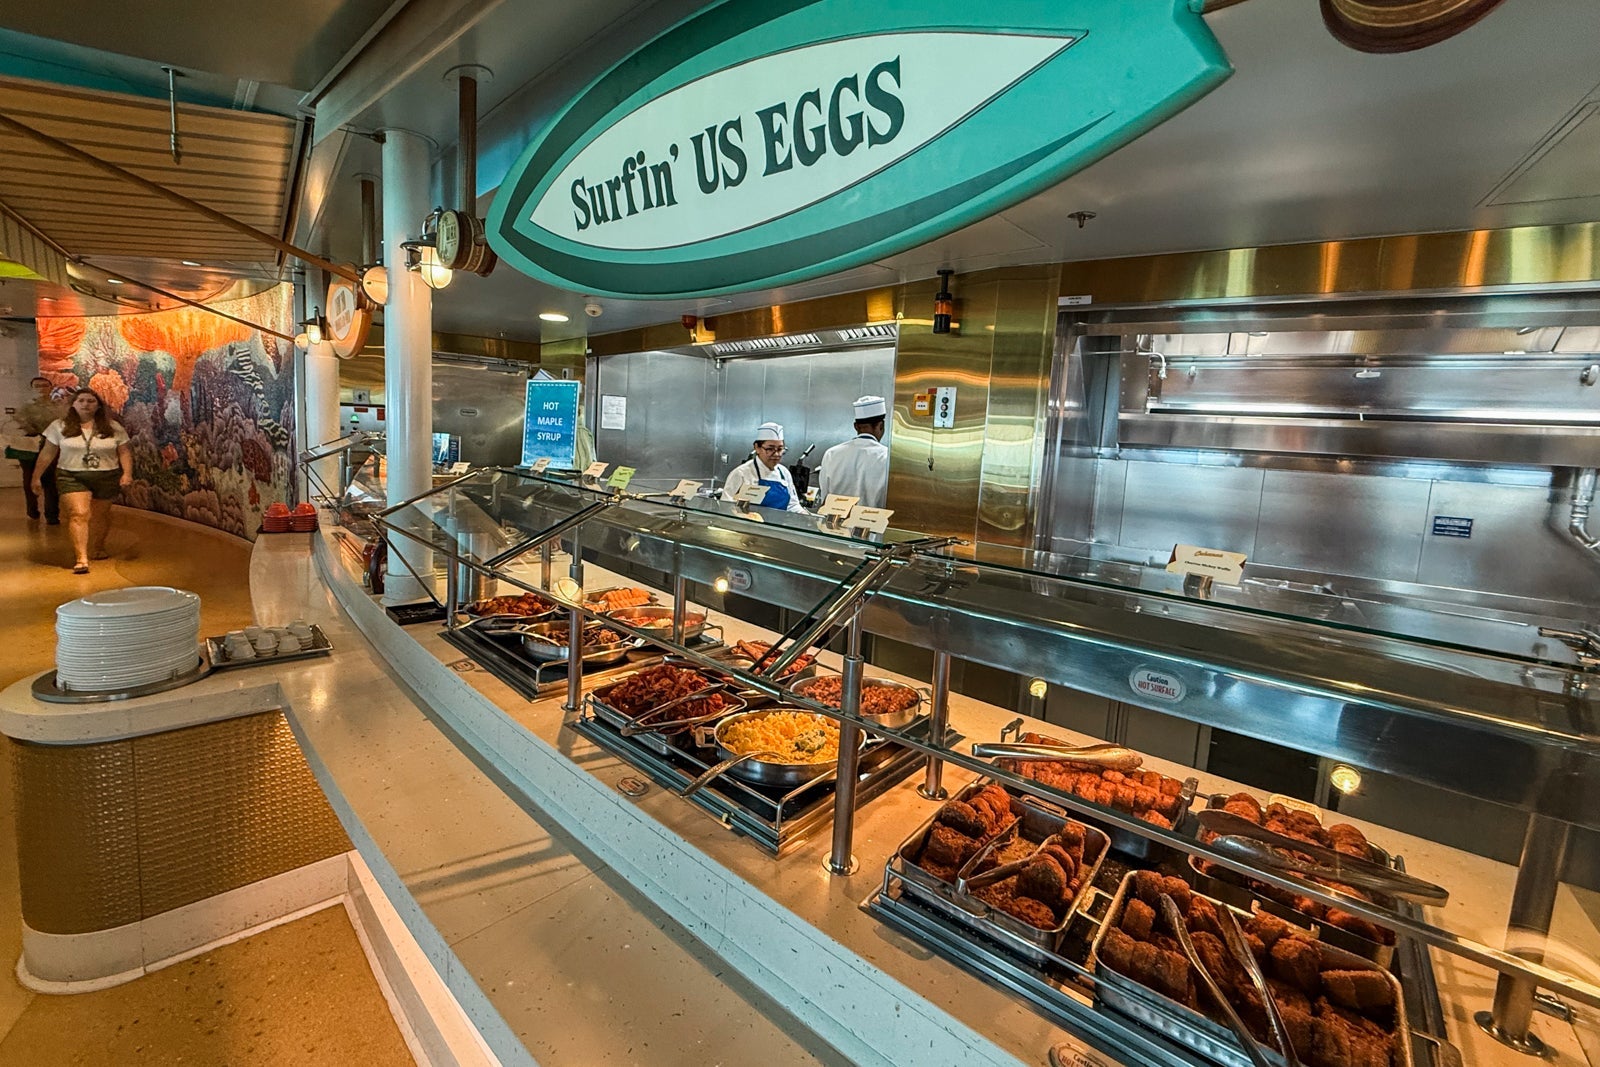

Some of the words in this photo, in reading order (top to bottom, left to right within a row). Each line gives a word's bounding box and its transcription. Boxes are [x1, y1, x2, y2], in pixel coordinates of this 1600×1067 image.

[570, 142, 680, 232] Surfin'
[689, 115, 748, 195] US
[755, 54, 905, 178] EGGS
[543, 401, 560, 411] HOT
[537, 416, 563, 426] MAPLE
[537, 432, 561, 442] SYRUP
[1146, 673, 1169, 686] Caution
[1137, 680, 1150, 691] HOT
[1151, 683, 1176, 697] SURFACE
